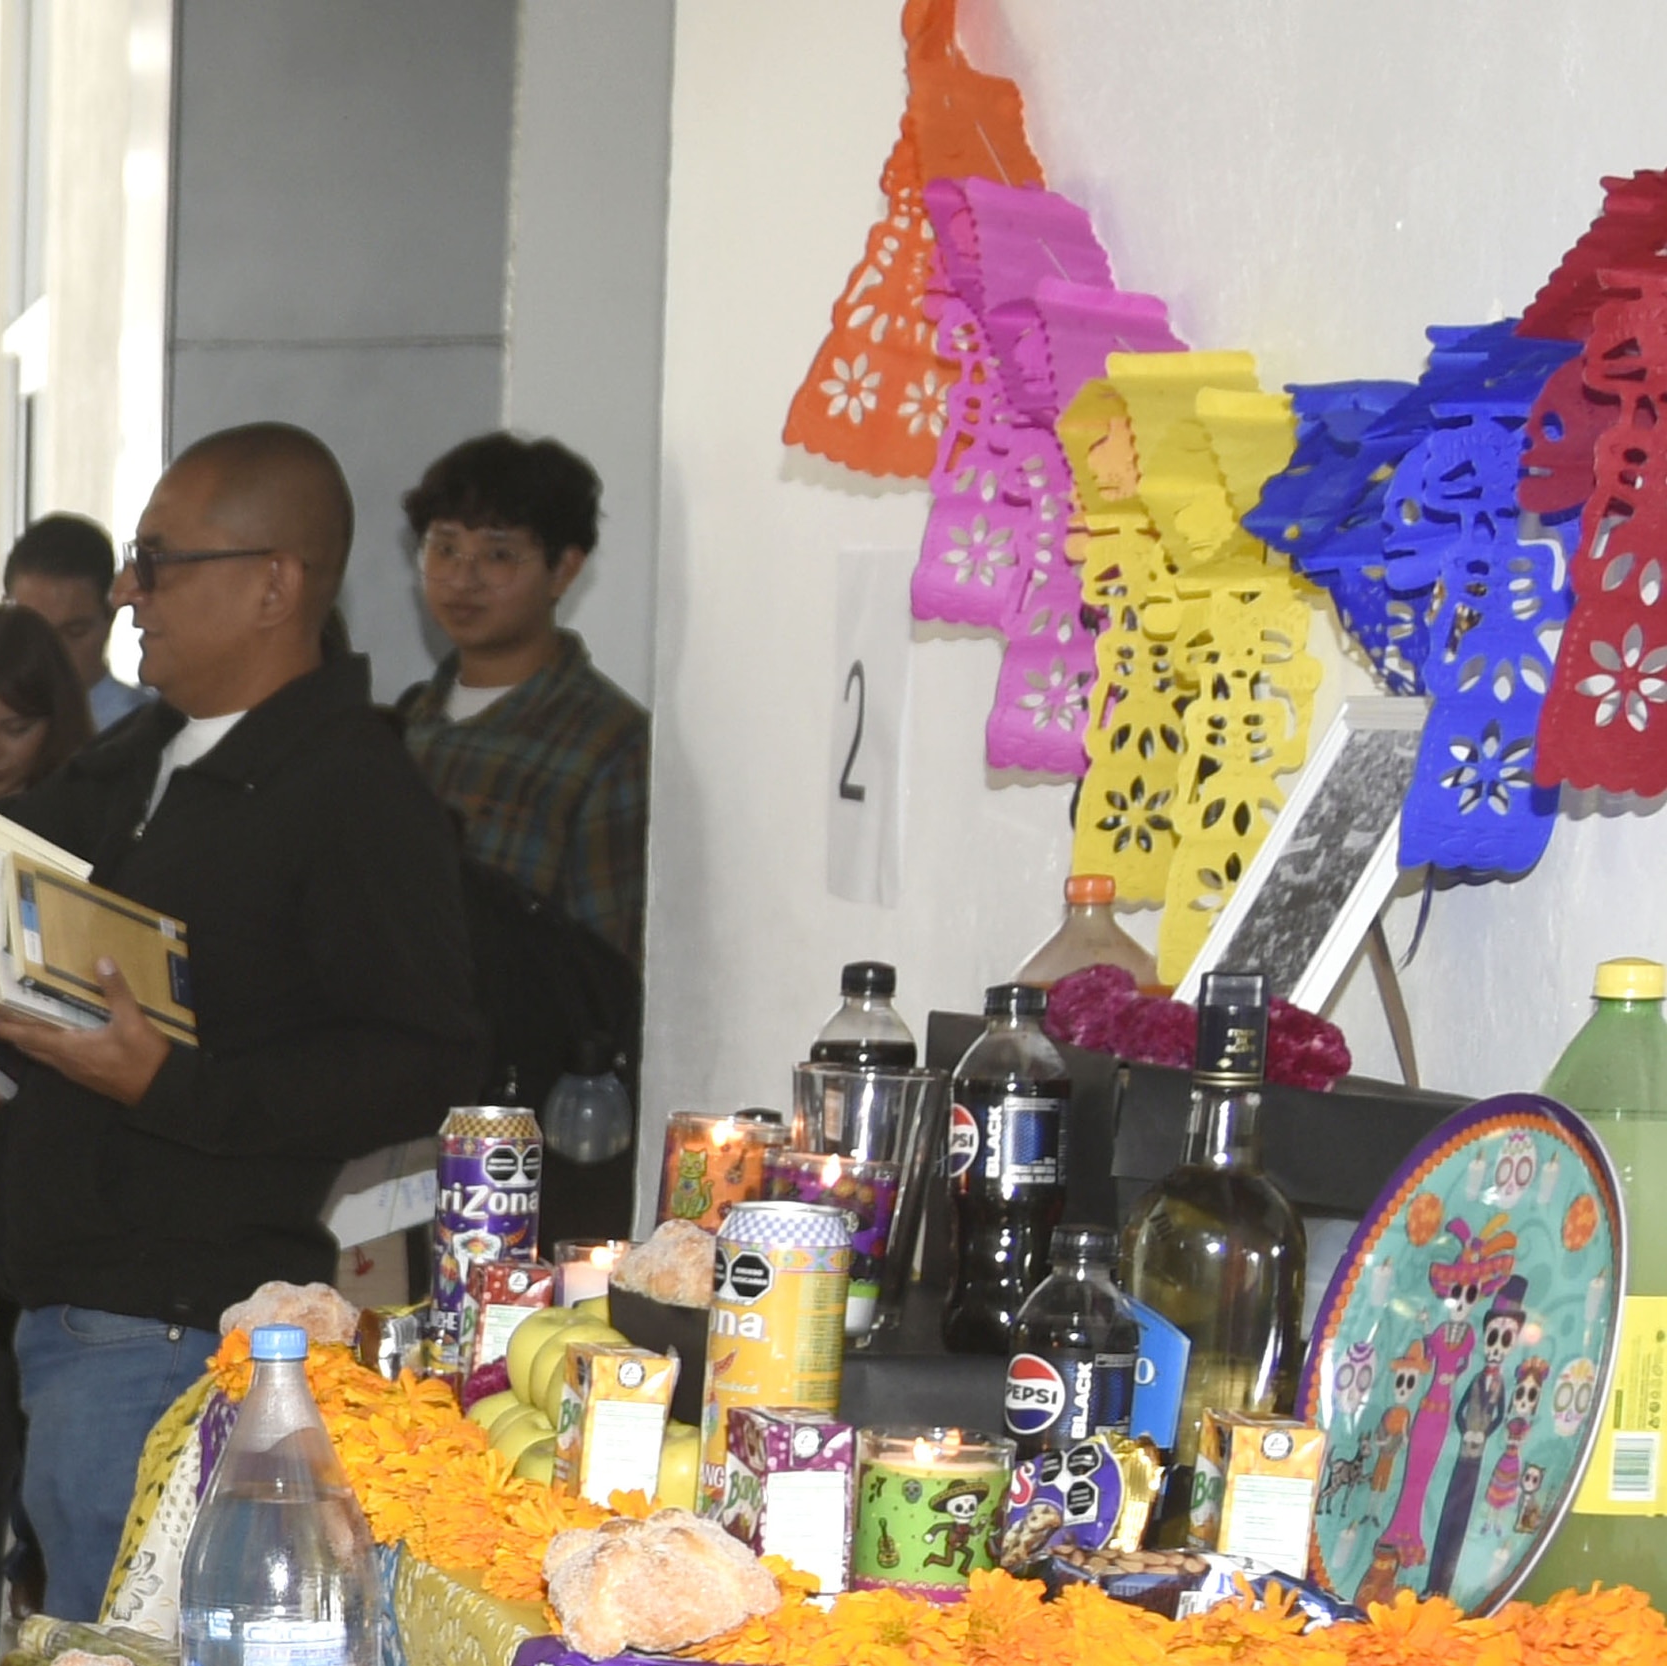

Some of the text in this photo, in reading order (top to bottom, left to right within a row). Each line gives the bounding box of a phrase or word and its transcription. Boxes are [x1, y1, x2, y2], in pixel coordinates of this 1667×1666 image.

[839, 659, 866, 803] 2
[985, 1105, 1003, 1179] BLACK
[436, 1182, 539, 1219] riZona
[1006, 1383, 1058, 1405] PEPSI
[1071, 1361, 1093, 1440] BLACK
